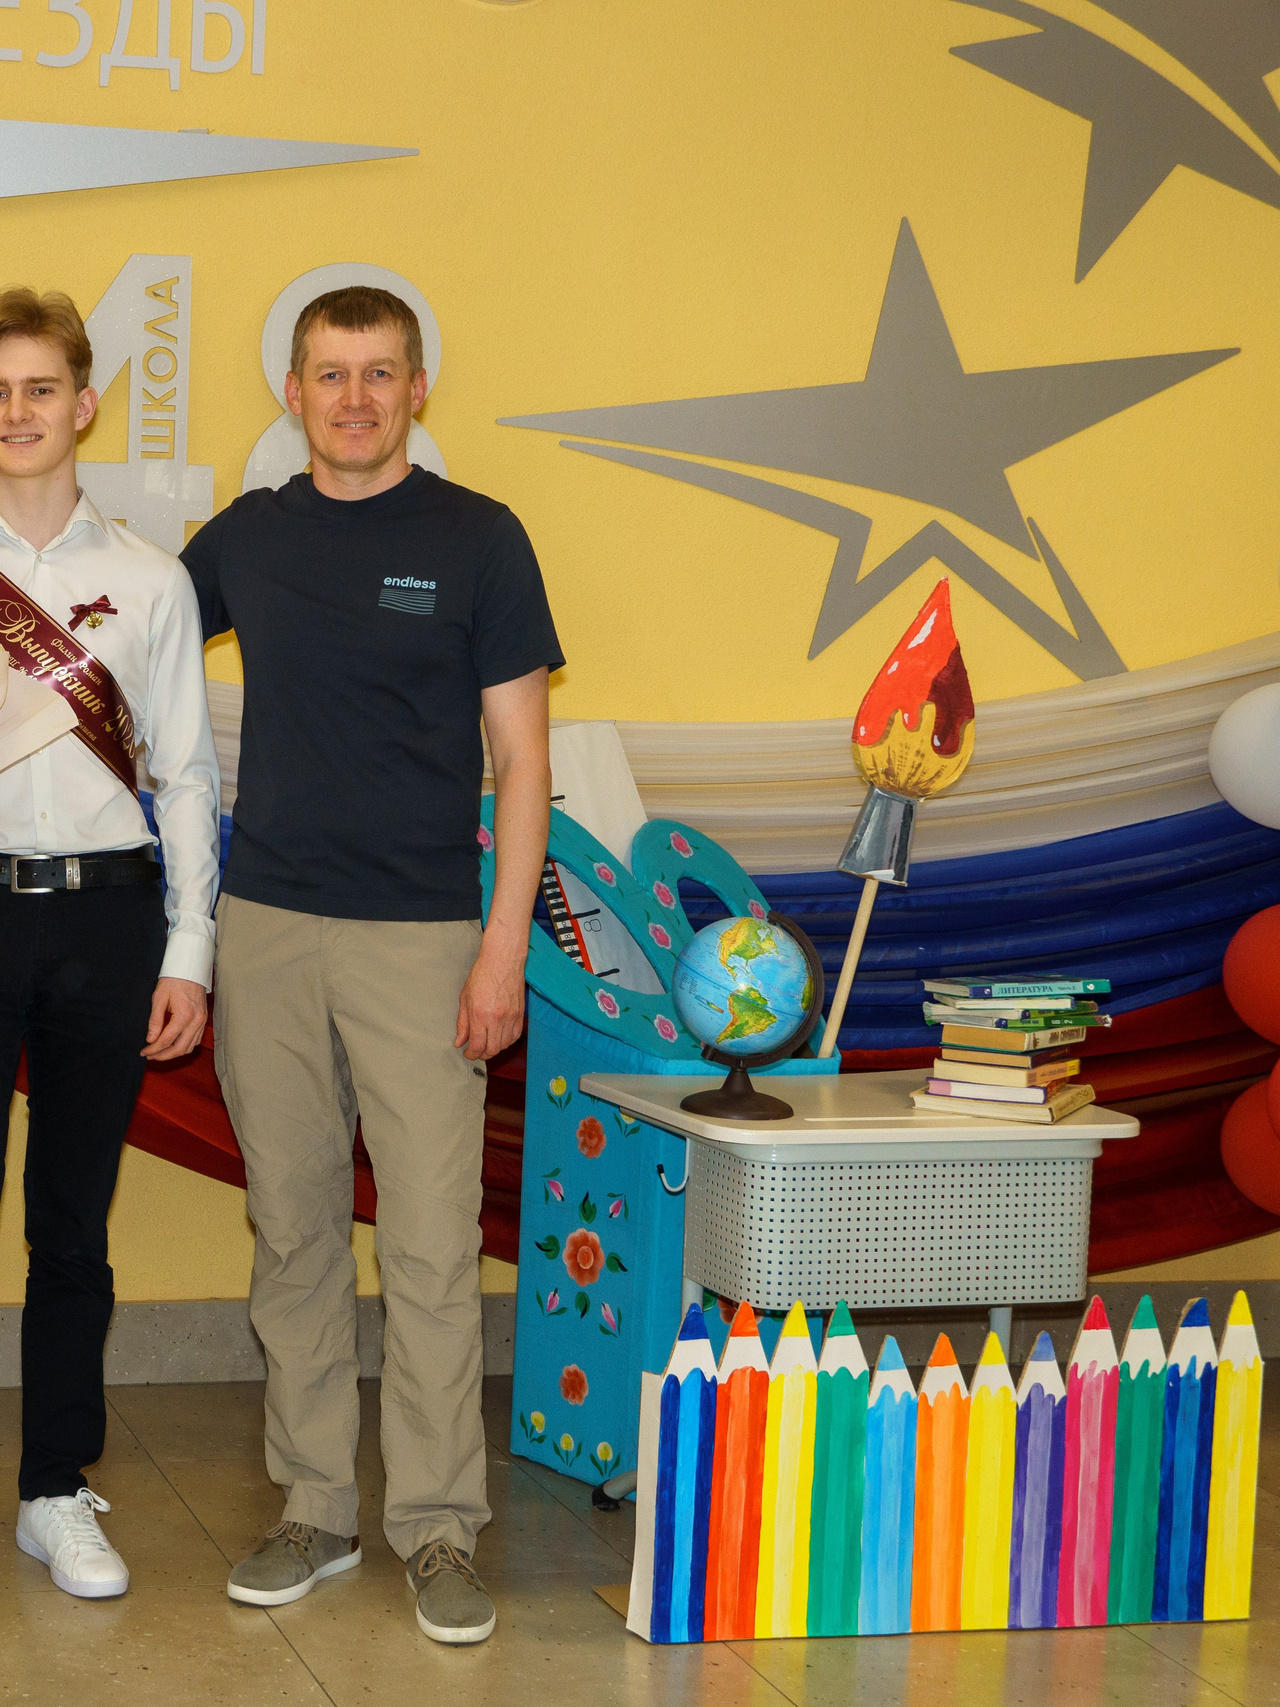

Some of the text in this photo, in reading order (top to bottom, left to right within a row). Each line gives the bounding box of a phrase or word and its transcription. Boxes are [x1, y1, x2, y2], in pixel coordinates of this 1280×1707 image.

[140, 276, 180, 460] ШКОЛА
[383, 576, 437, 590] endless
[51, 638, 102, 686] Филин Роман
[584, 919, 602, 932] 8
[997, 985, 1053, 994] ЛИТЕРАТУРА
